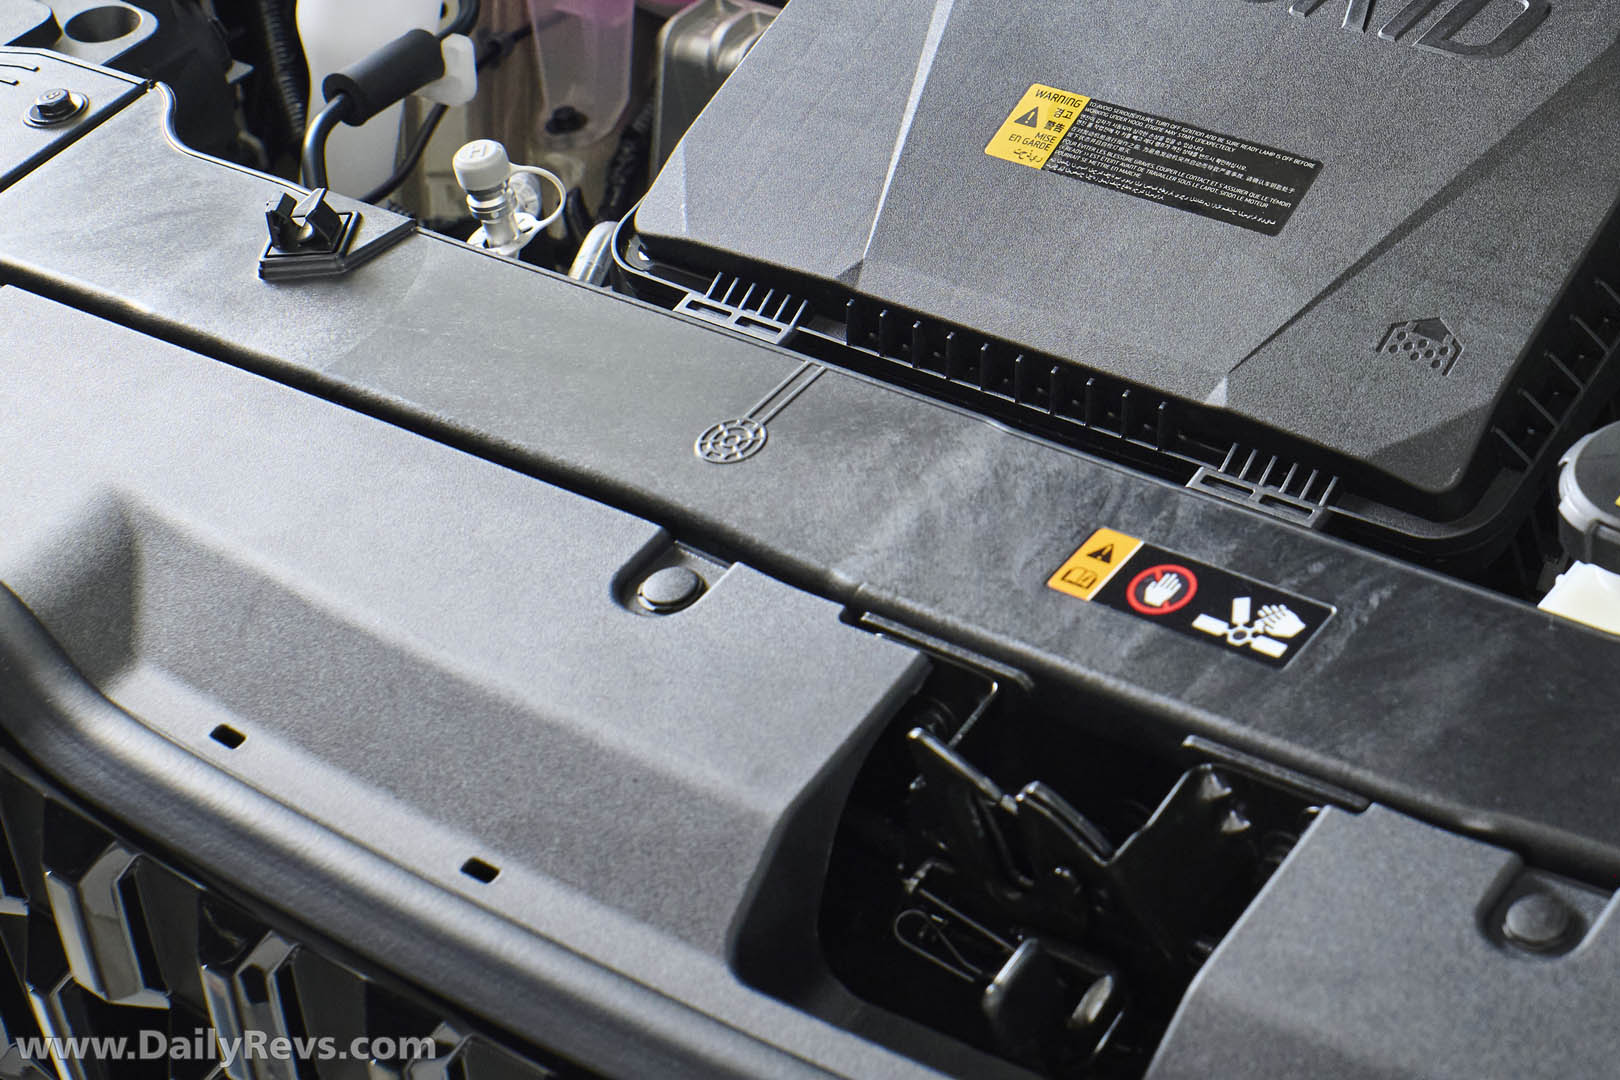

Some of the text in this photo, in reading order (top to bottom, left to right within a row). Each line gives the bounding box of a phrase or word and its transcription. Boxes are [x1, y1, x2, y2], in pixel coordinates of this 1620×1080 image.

[1035, 89, 1083, 108] WARNING
[1053, 107, 1074, 120] 경고
[1008, 133, 1052, 151] EN GARDE
[1034, 132, 1057, 143] MISE
